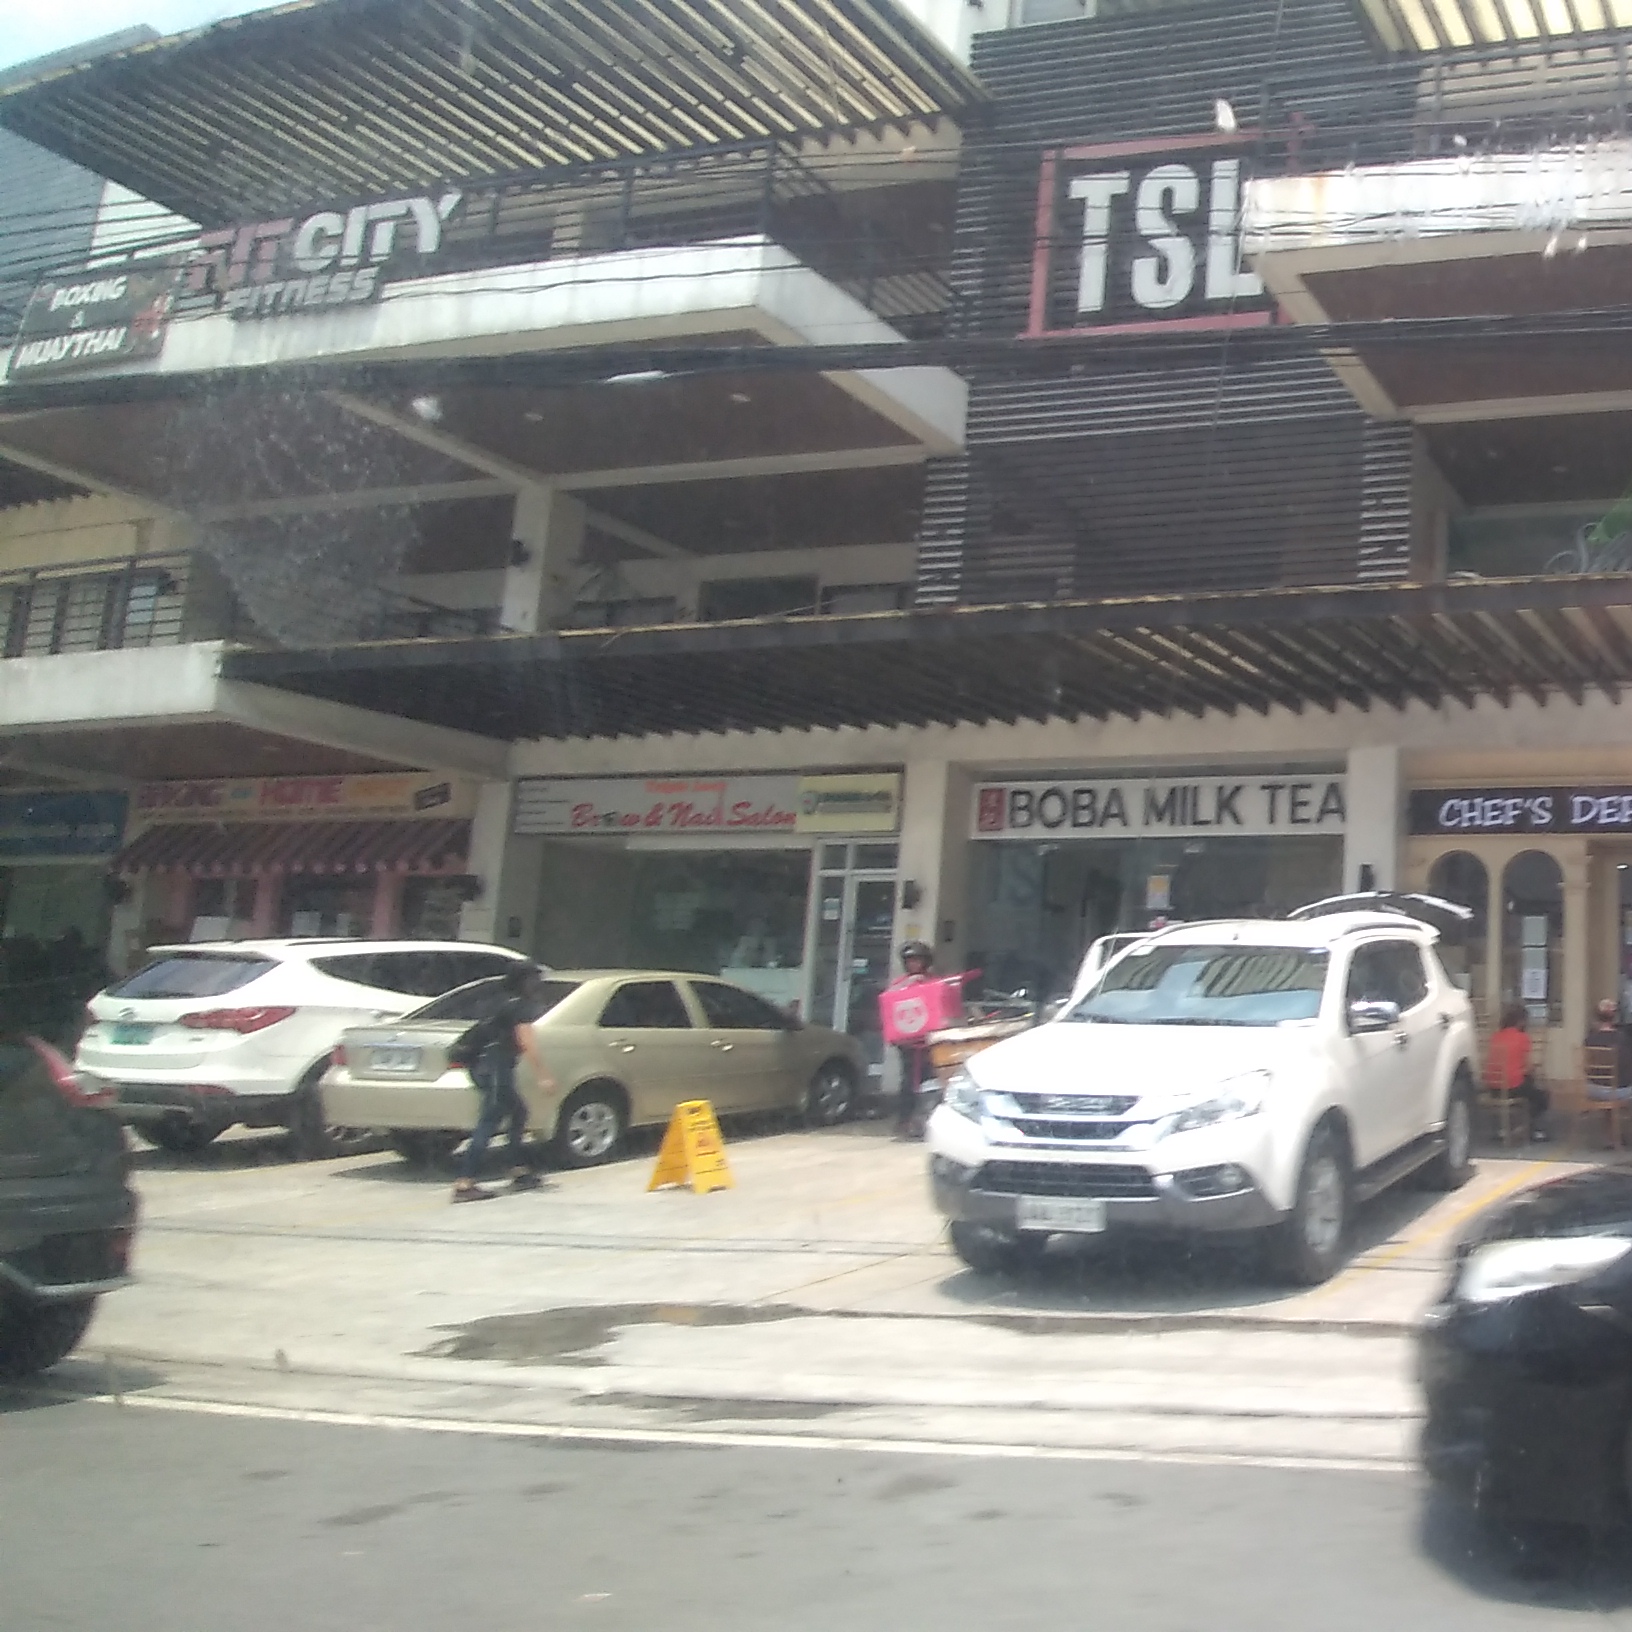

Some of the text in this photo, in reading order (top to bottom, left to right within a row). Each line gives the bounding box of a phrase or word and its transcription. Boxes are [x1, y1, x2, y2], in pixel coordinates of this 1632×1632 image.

[293, 187, 463, 273] CITY
[1068, 158, 1265, 314] TSL
[49, 275, 128, 312] BOXING
[222, 264, 382, 310] FITNESS
[1008, 786, 1129, 830] BOBA
[1142, 784, 1244, 827] MILK
[1260, 781, 1348, 825] TEA
[1438, 797, 1554, 828] CHEF'S
